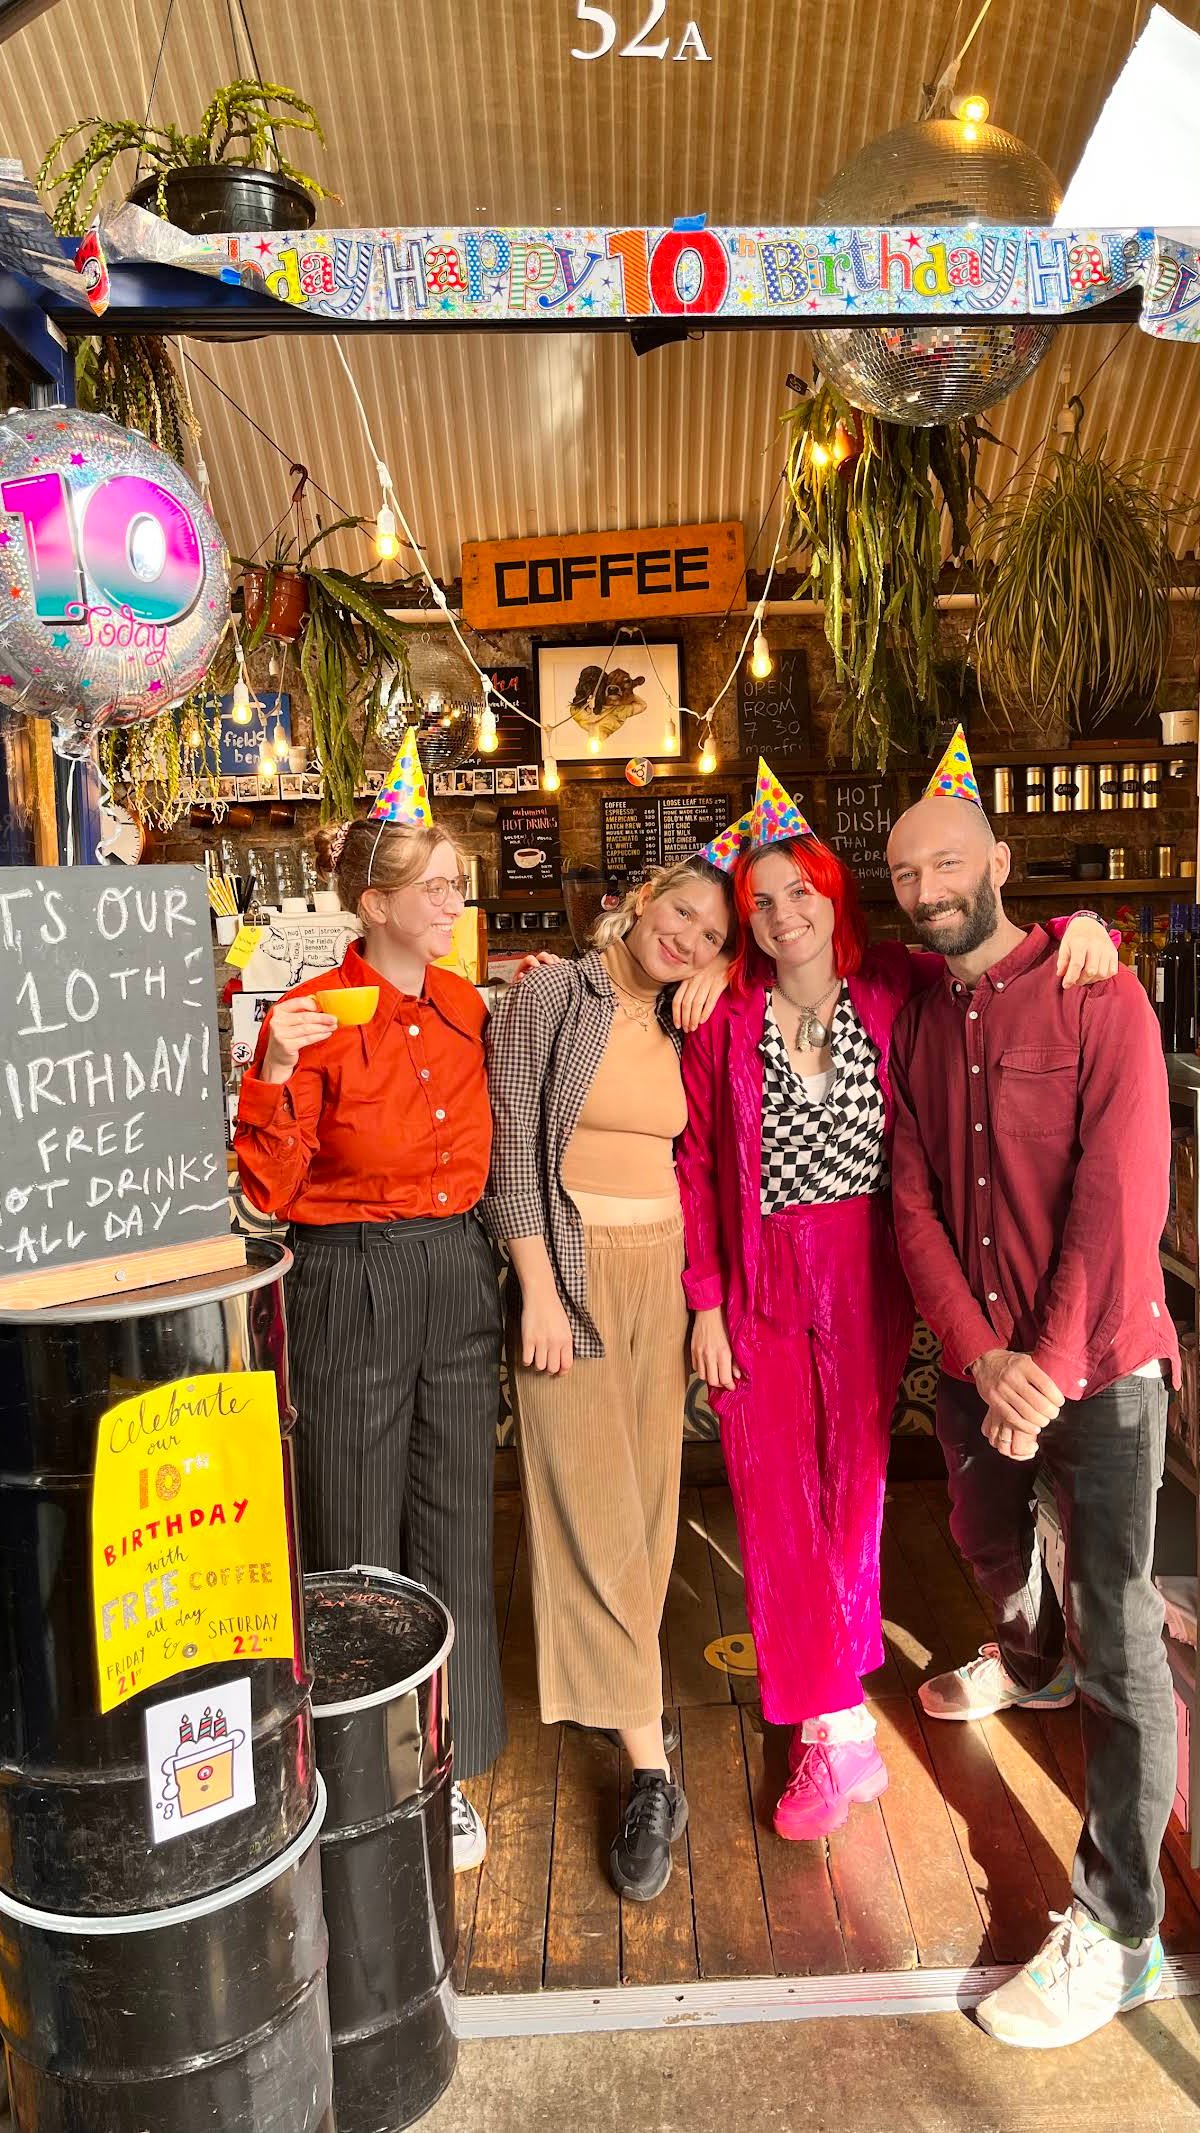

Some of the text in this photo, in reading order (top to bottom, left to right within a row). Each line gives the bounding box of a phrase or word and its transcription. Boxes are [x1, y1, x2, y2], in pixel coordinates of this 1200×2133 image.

[571, 0, 712, 61] 52A
[381, 231, 603, 312] Happy
[758, 229, 1021, 310] Birthday
[0, 472, 206, 627] 10
[494, 547, 709, 607] COFFEE
[64, 601, 168, 666] Today
[744, 676, 792, 697] OPEN
[743, 698, 796, 718] FROM
[772, 720, 801, 736] 30
[604, 801, 627, 809] COFFEE
[662, 799, 681, 808] LOOSE
[682, 799, 697, 807] LEAF
[698, 798, 713, 806] TEAS
[837, 784, 883, 807] HOT
[502, 816, 558, 831] HOT DRINKS
[604, 808, 634, 816] ESPRESSO
[605, 815, 638, 823] AMERICANO
[605, 823, 624, 831] BATCH
[624, 822, 642, 830] BREW
[663, 822, 675, 830] HOT
[836, 809, 891, 834] DISH
[663, 829, 675, 837] HOT
[830, 836, 867, 851] THAI
[0, 880, 197, 945] T'S OUR
[17, 965, 166, 1036] 10TH
[0, 1026, 209, 1123] IRTHDAY!
[38, 1112, 145, 1174] FREE
[2, 1152, 217, 1216] OT DRINKS
[14, 1197, 172, 1264] ALL DAY
[110, 1382, 254, 1454] Celebrate
[147, 1434, 181, 1456] our
[103, 1498, 249, 1568] BIRTHDAY
[145, 1545, 190, 1574] with
[101, 1562, 273, 1642] FREE COFFEE
[145, 1606, 208, 1640] all day
[208, 1612, 278, 1640] SATURDAY
[107, 1646, 146, 1681] FRIDAY
